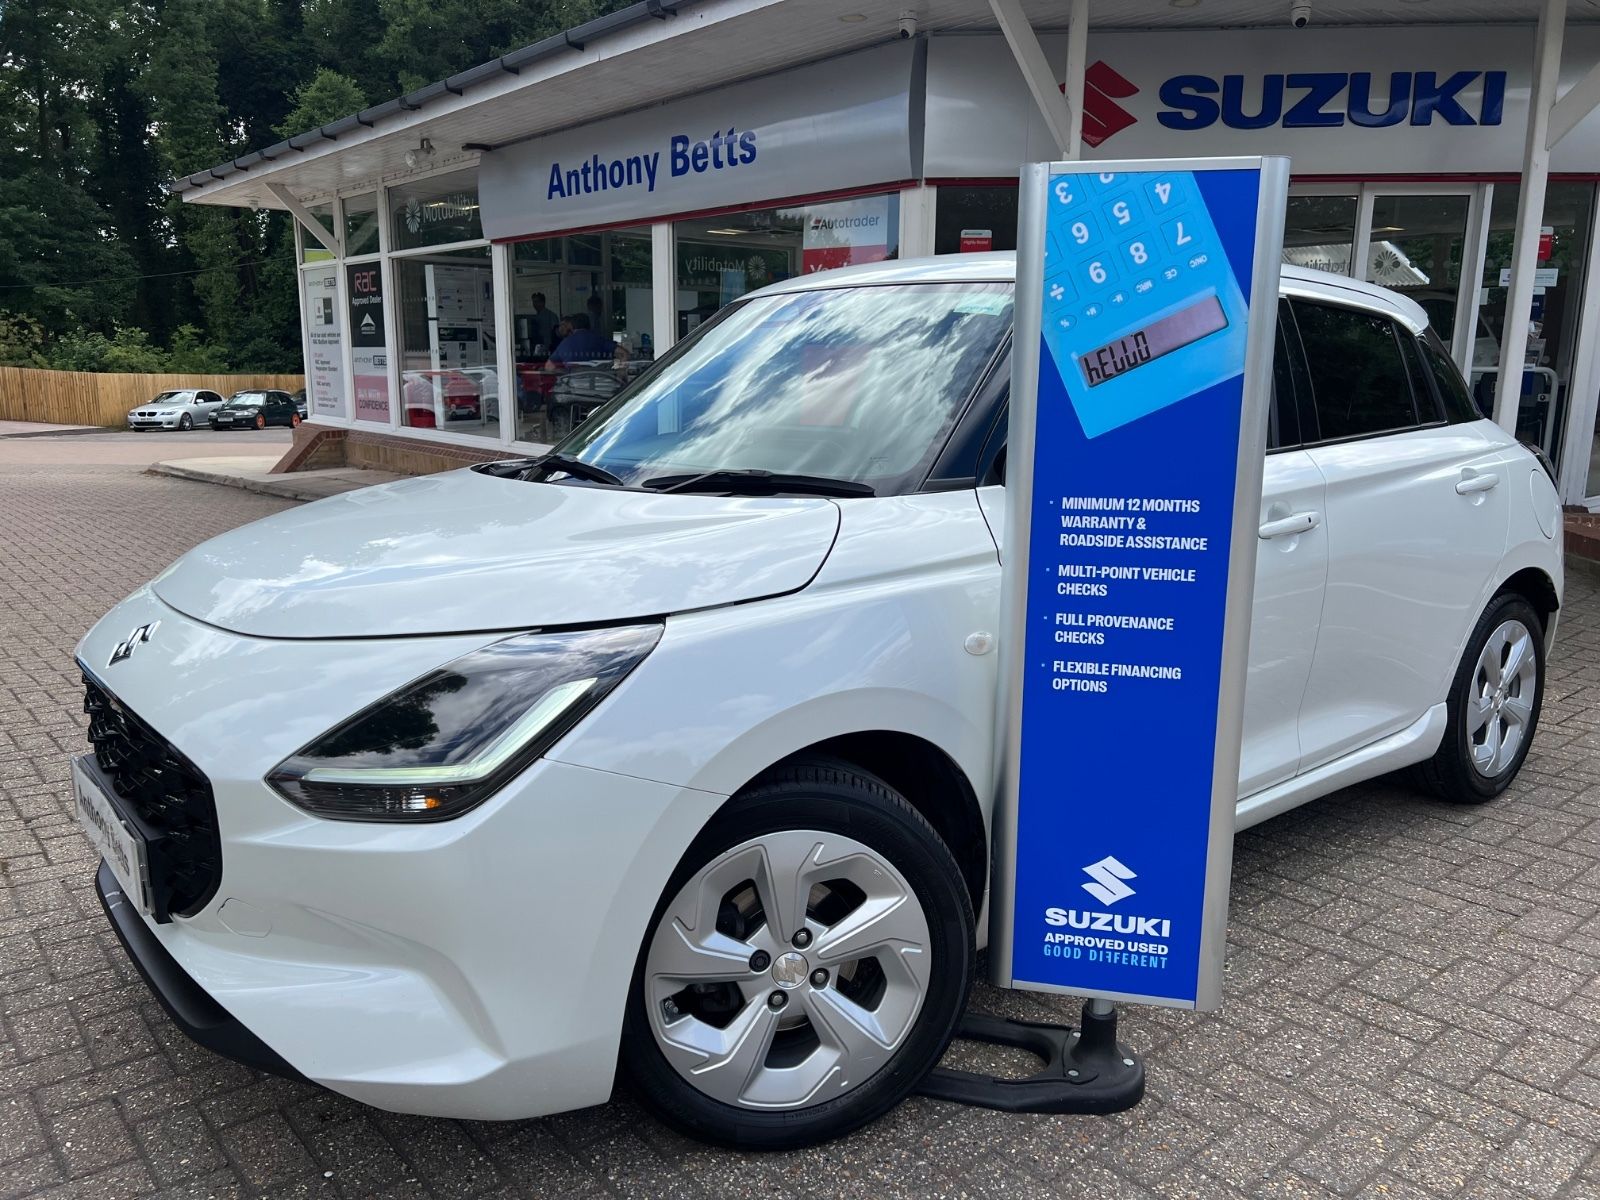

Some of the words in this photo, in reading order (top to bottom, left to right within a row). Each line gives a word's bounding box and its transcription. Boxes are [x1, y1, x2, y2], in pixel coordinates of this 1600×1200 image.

[1156, 70, 1508, 131] SUZUKI
[547, 152, 660, 200] Anthony
[670, 127, 757, 177] Betts
[1055, 182, 1072, 204] 3
[1154, 182, 1171, 204] 4
[1112, 201, 1130, 225] 5
[821, 215, 880, 231] Autotrader
[1176, 222, 1192, 246] 7
[1130, 242, 1148, 264] 8
[352, 297, 369, 307] Approved
[370, 295, 382, 304] Dealer
[359, 399, 389, 411] CONFIDENCE
[1061, 496, 1125, 511] MINIMUM
[1126, 498, 1140, 511] 12
[1142, 499, 1200, 513] MONTHS
[1061, 515, 1135, 530] WARRANTY
[1136, 517, 1147, 530] &
[1059, 533, 1124, 548] ROADSIDE
[1125, 536, 1208, 550] ASSISTANCE
[1058, 565, 1140, 579] MULTI-POINT
[1142, 567, 1196, 582] VEHICLE
[1057, 582, 1108, 596] CHECKS
[1055, 613, 1085, 626] FULL
[1087, 614, 1174, 630] PROVENANCE
[1055, 631, 1105, 644] CHECKS
[1053, 660, 1109, 675] FLEXIBLE
[1111, 663, 1182, 680] FINANCING
[1052, 678, 1108, 692] OPTIONS
[1044, 907, 1171, 938] SUZUKI
[1044, 932, 1125, 950] APPROVED
[1127, 941, 1169, 955] USED
[1043, 944, 1081, 959] GOOD
[1089, 949, 1168, 969] DIFFERENT
